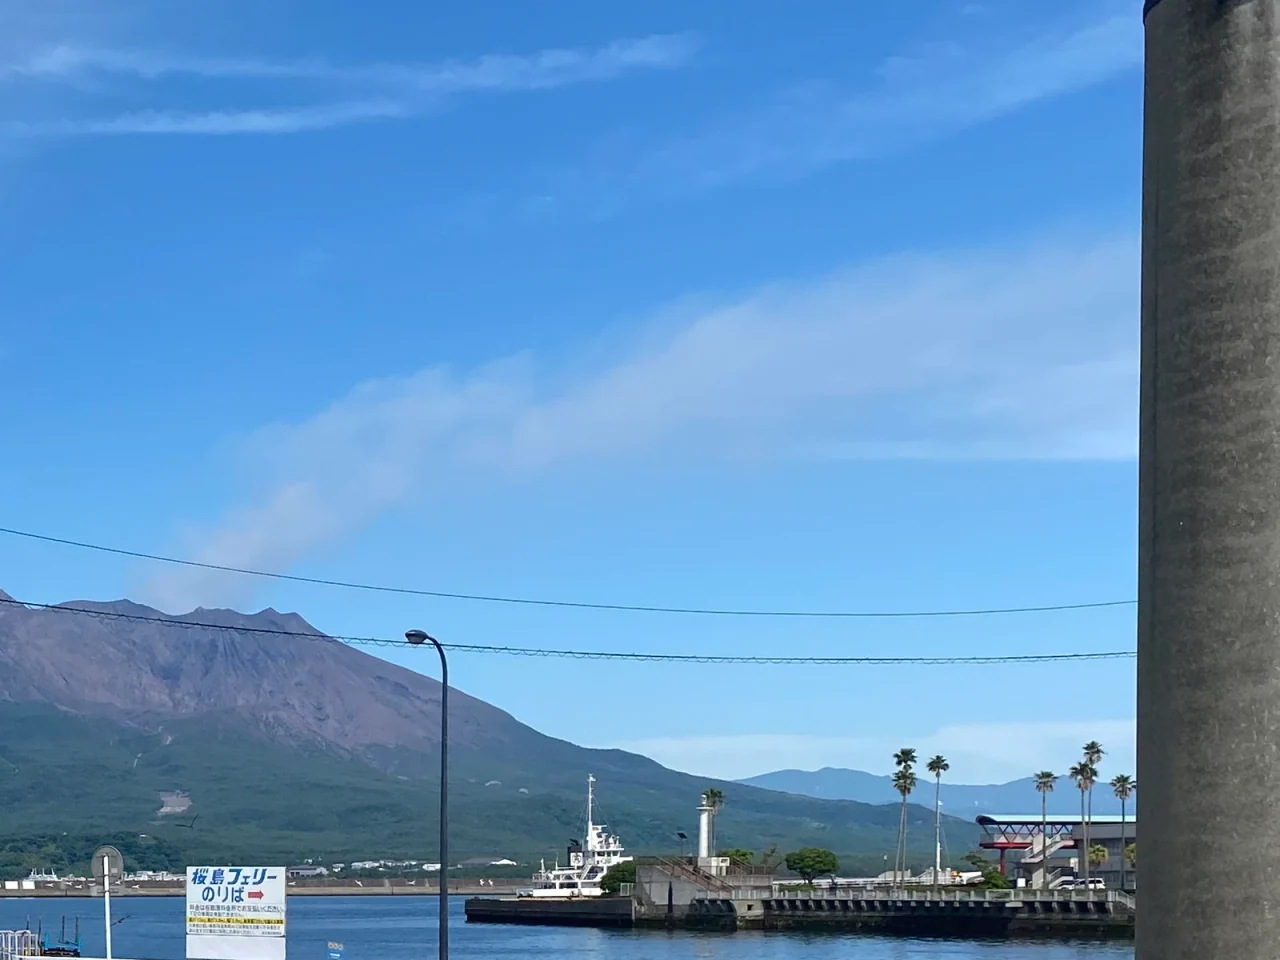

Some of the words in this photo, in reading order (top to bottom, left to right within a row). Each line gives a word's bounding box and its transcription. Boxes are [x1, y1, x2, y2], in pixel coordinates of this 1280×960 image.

[191, 868, 278, 885] 桜島フェリー
[202, 886, 245, 903] のりば
